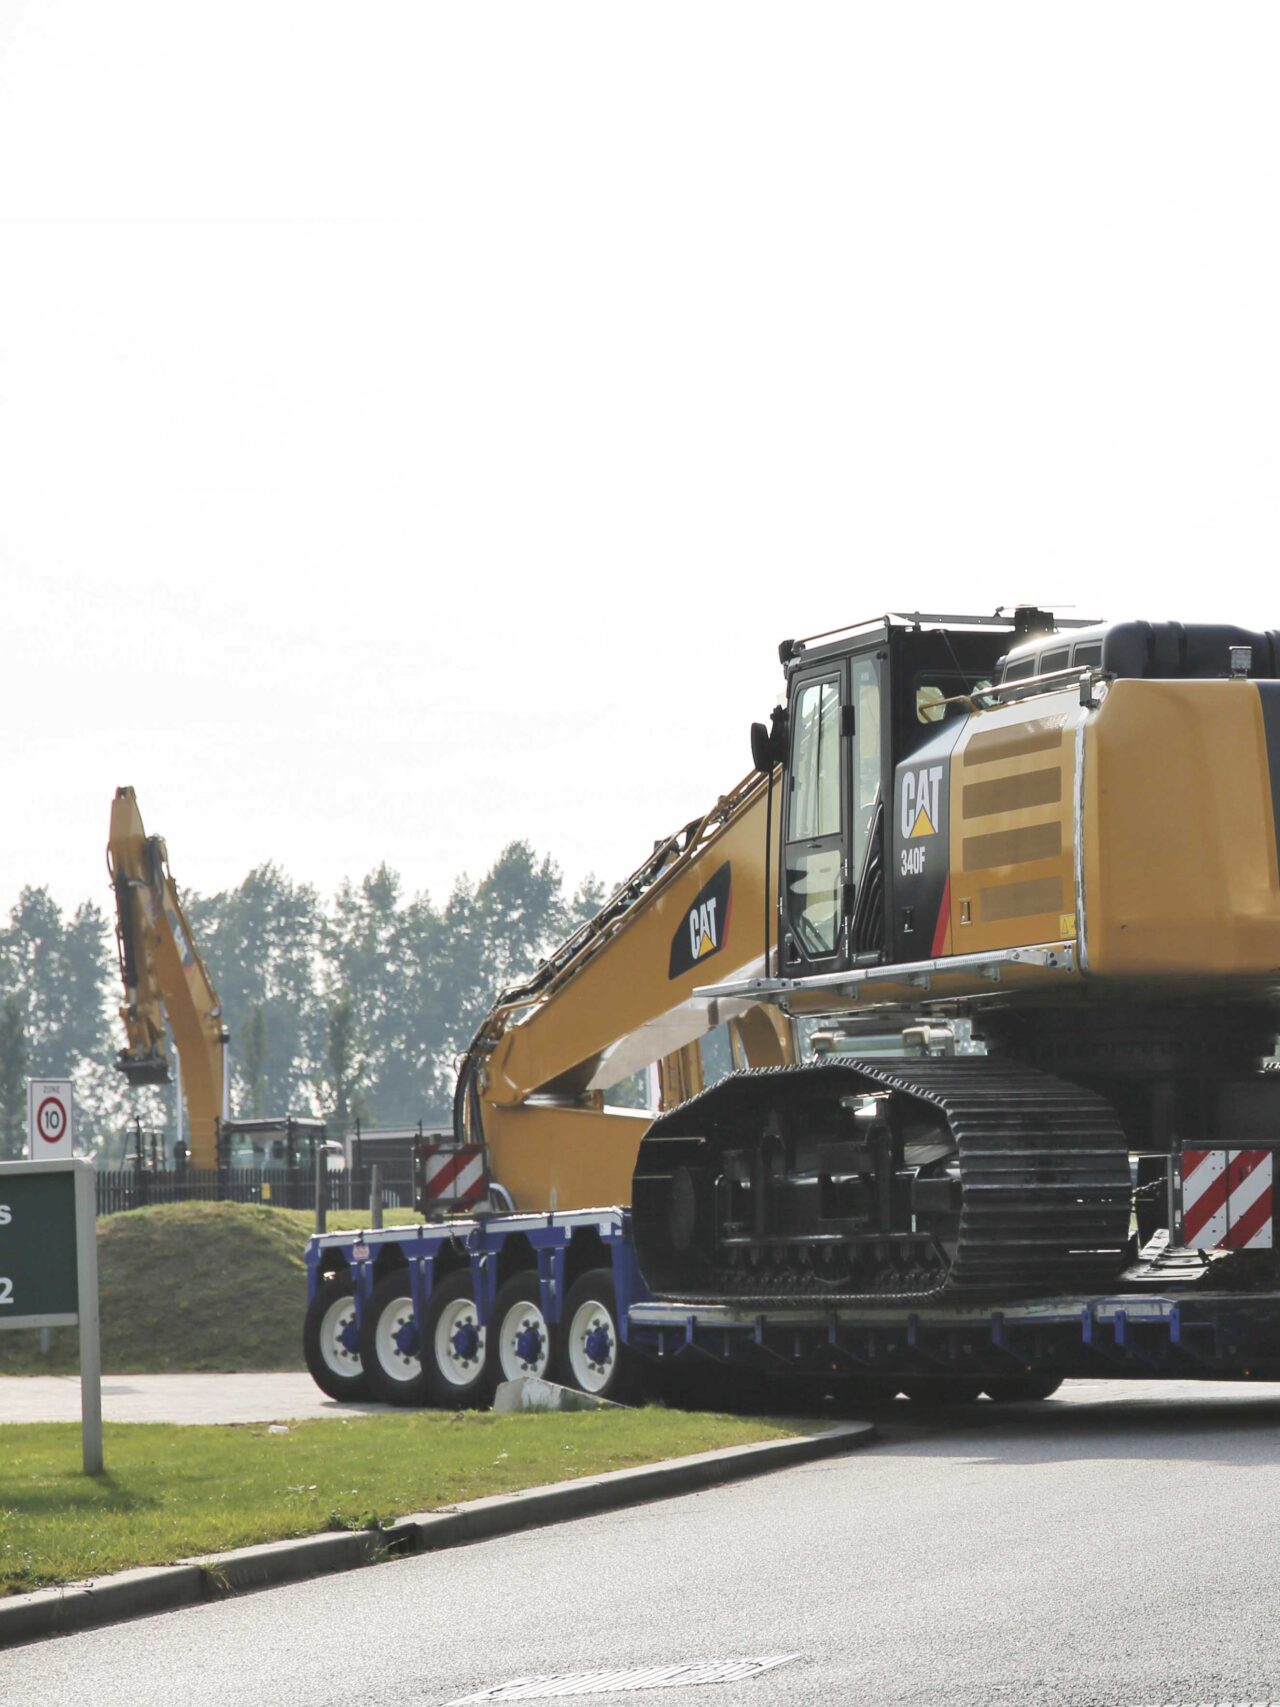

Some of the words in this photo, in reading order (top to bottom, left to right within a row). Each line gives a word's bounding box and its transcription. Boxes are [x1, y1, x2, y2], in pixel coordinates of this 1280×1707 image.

[901, 766, 943, 840] CAT
[901, 846, 926, 877] 340F
[689, 897, 717, 960] CAT
[45, 1111, 59, 1129] 10
